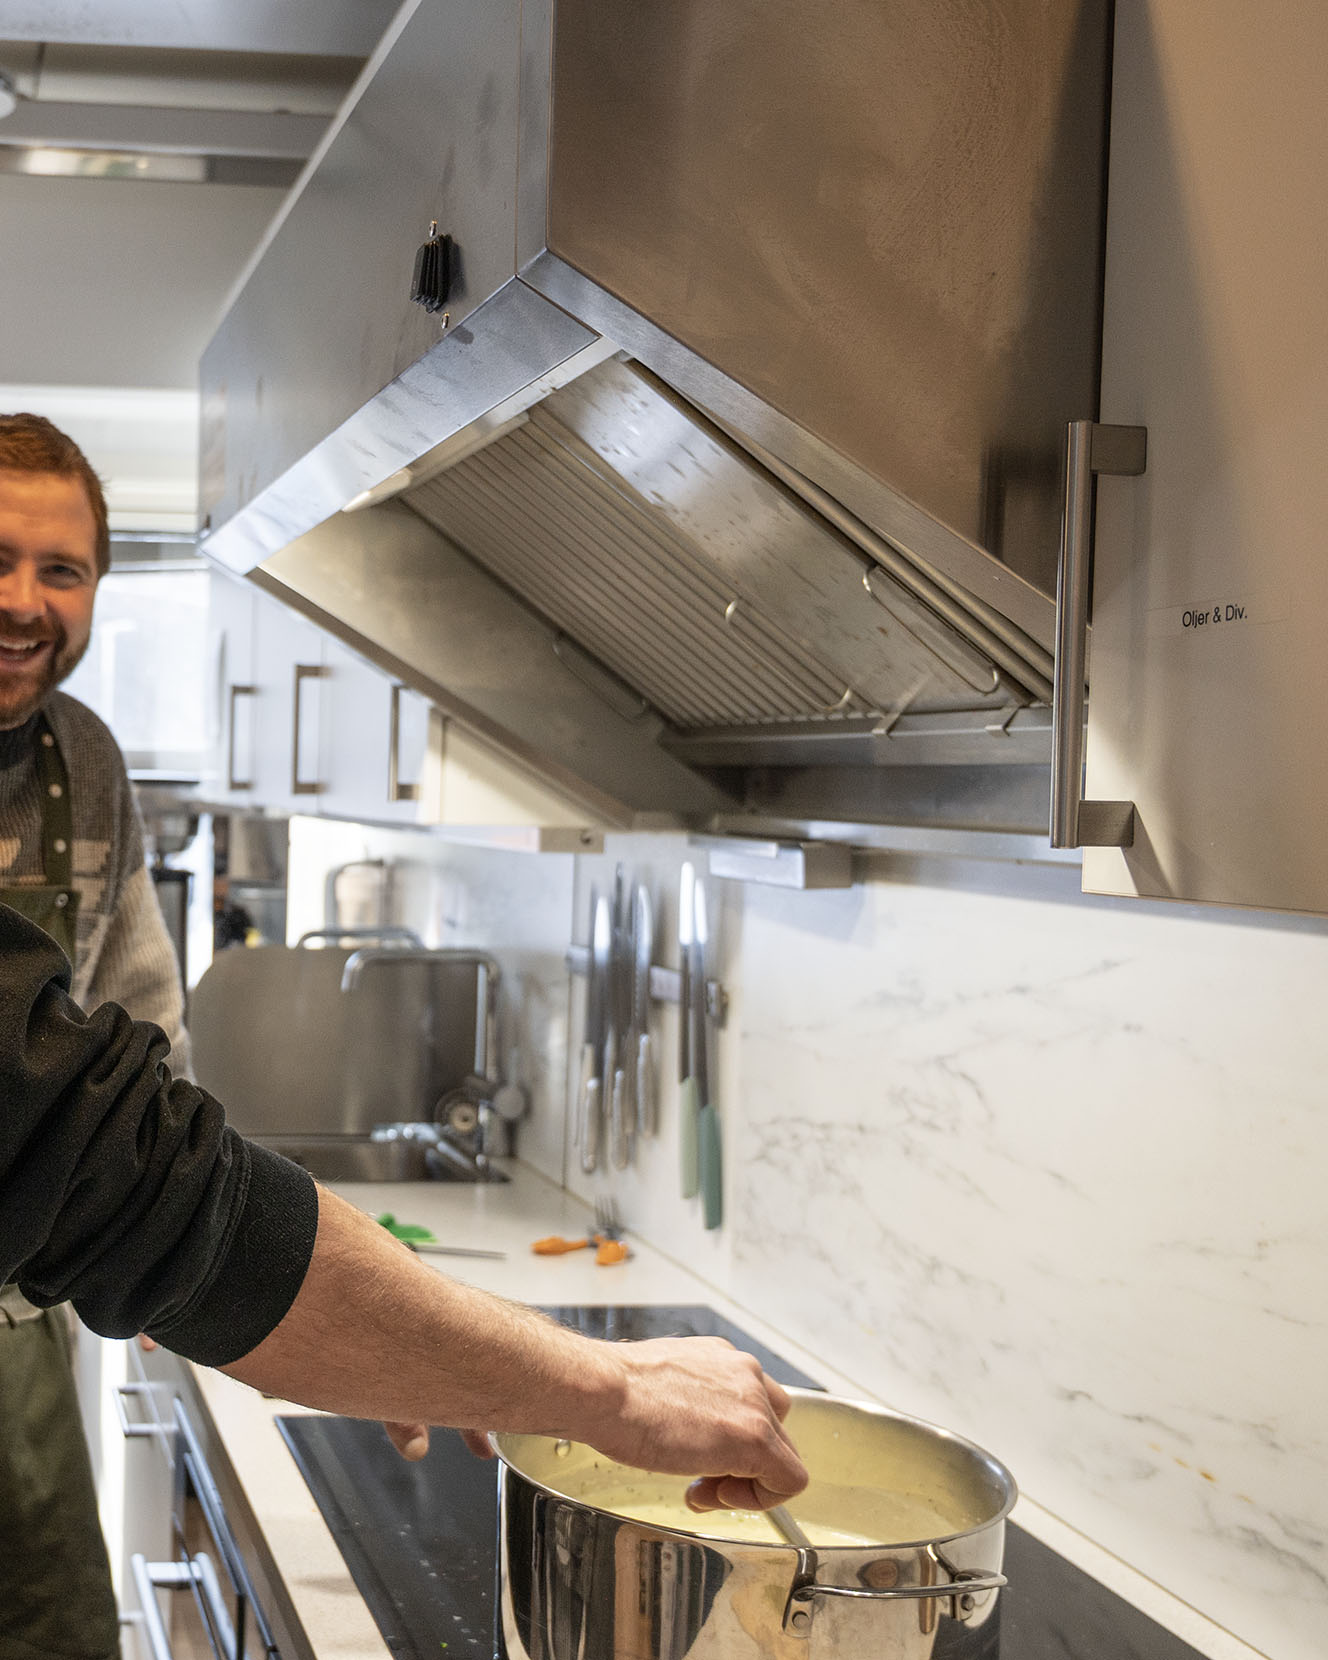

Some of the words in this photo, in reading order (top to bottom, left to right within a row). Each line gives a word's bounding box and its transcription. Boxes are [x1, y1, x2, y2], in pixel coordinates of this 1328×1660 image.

[1182, 609, 1209, 628] Oljer
[1212, 606, 1221, 623] &
[1225, 603, 1248, 621] Div.
